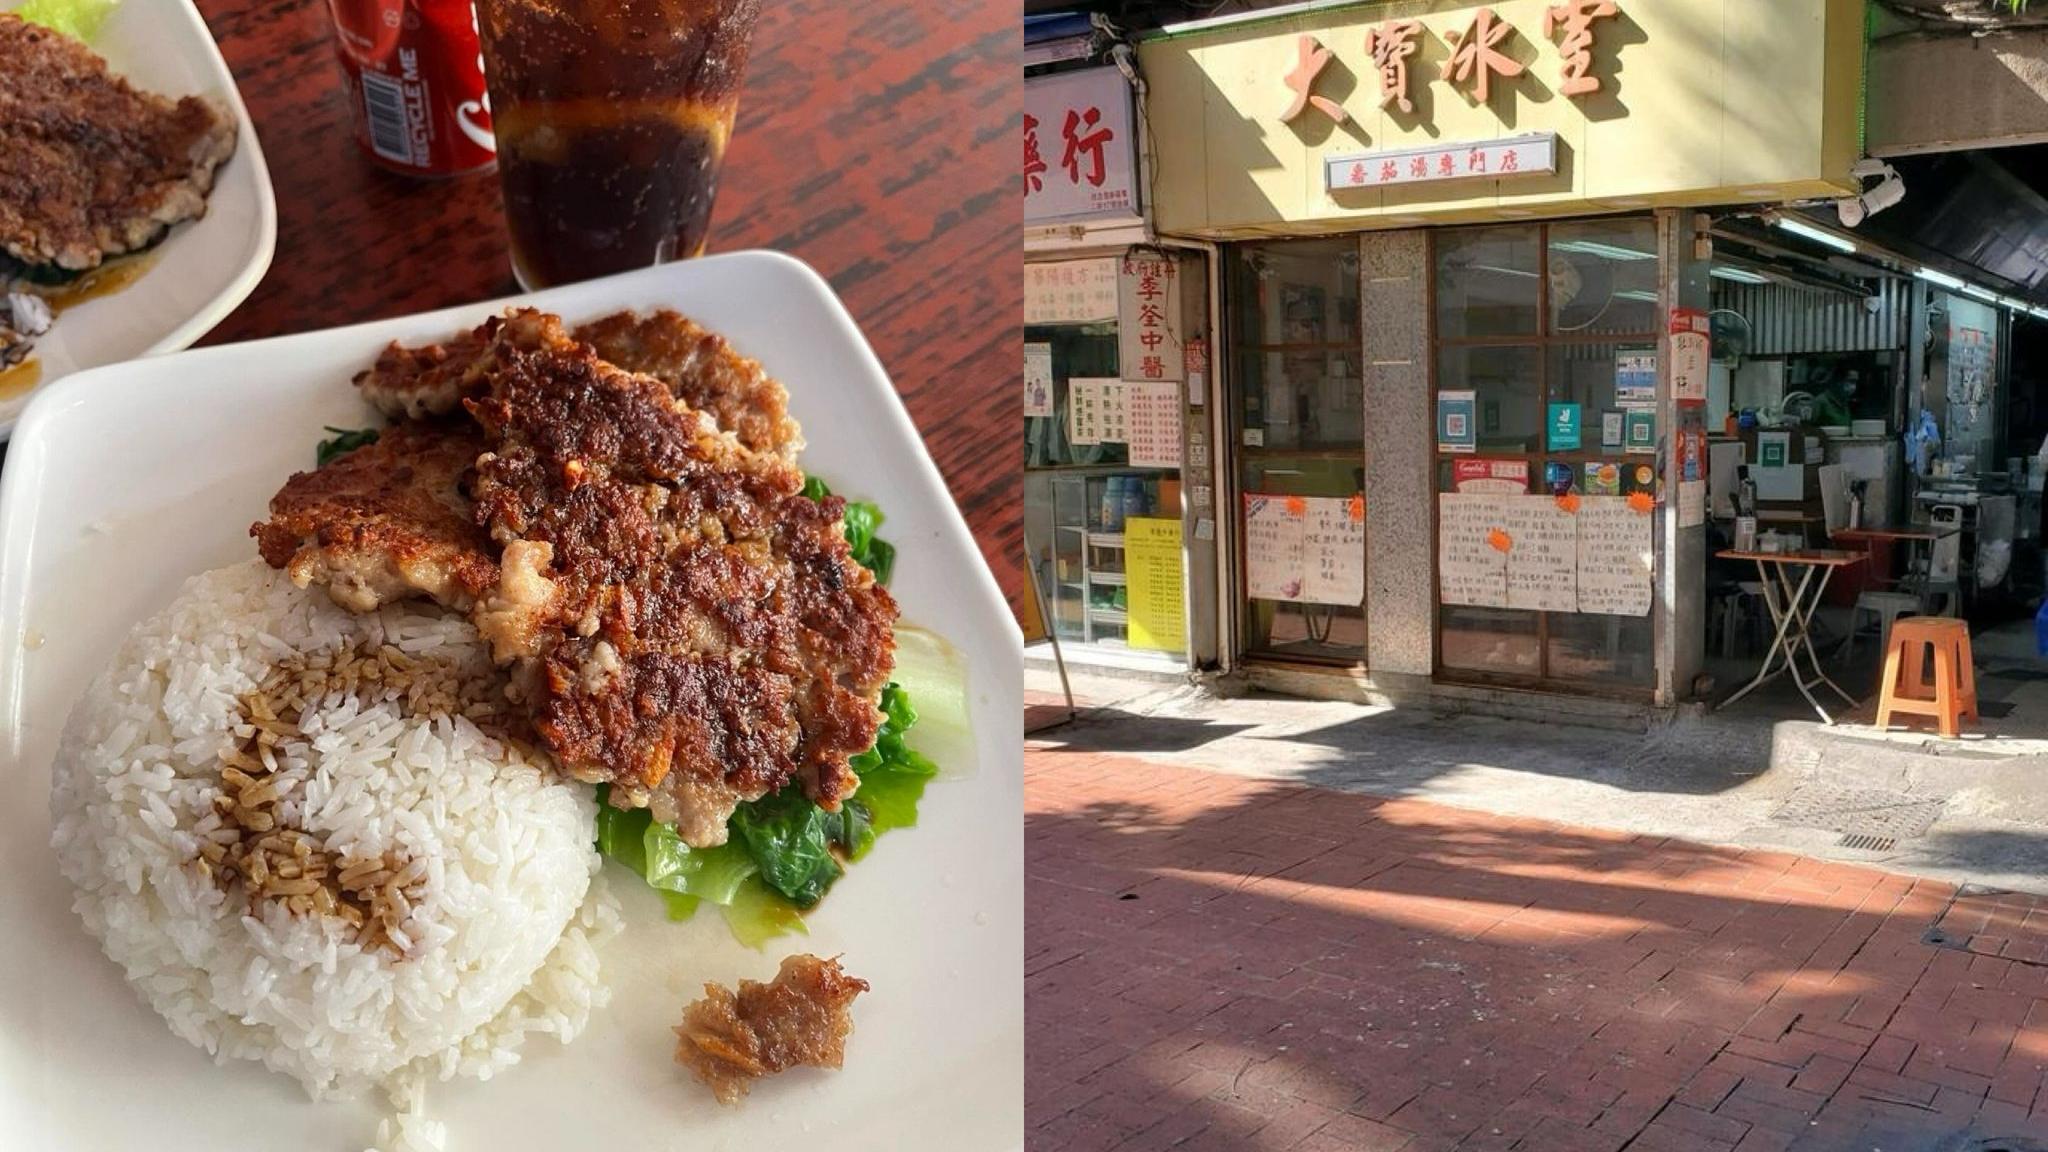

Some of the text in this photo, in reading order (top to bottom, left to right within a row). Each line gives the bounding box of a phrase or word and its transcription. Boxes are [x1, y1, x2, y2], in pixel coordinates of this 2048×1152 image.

[400, 48, 431, 168] RECYCLE ME
[1279, 0, 1618, 122] 大寶冰室
[1350, 149, 1519, 183] 番茄湯專門店
